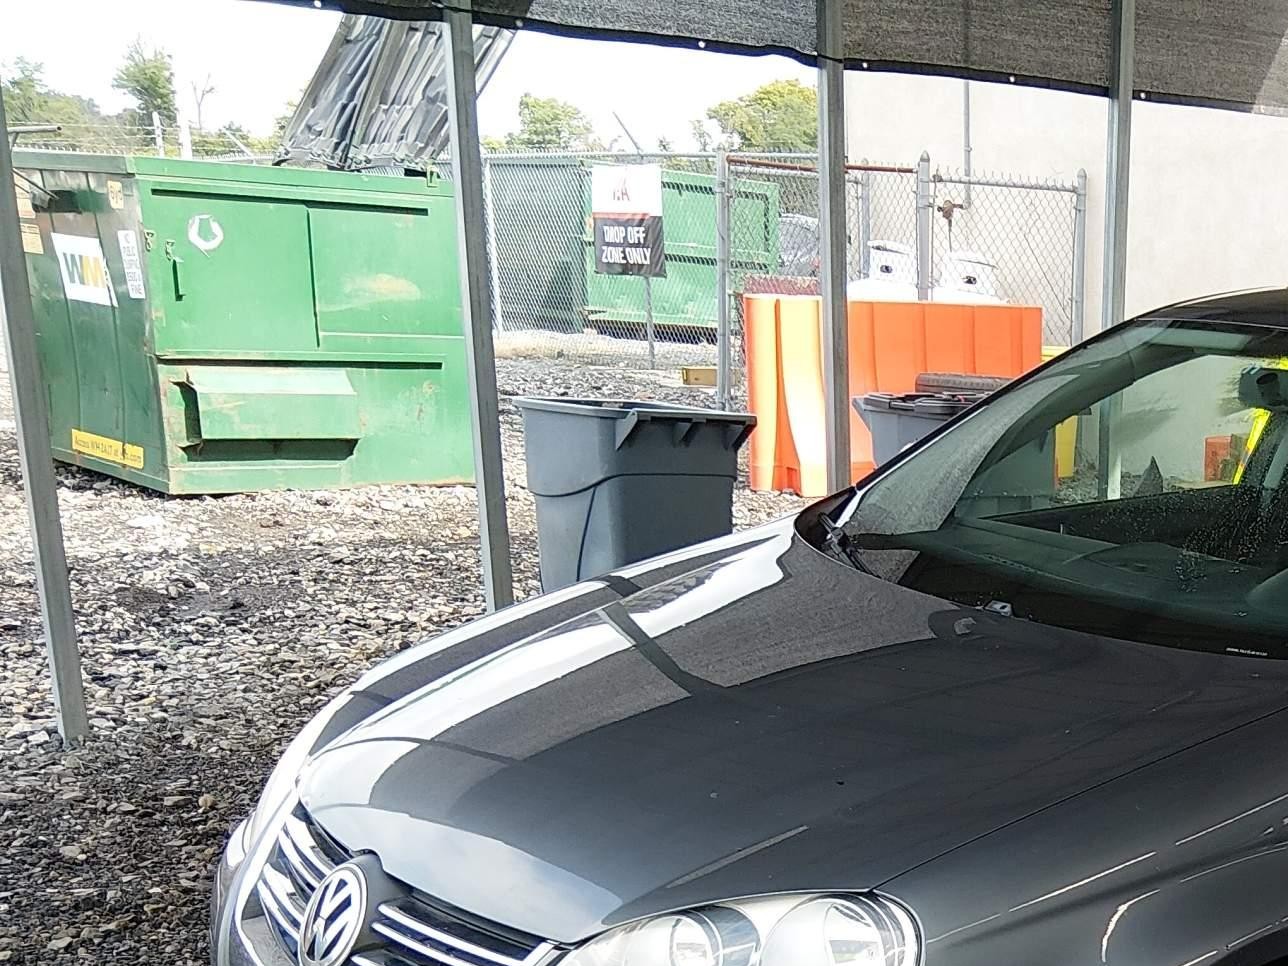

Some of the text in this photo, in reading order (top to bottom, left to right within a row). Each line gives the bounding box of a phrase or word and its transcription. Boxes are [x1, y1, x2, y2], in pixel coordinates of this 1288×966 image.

[603, 225, 647, 244] DROP OFF
[601, 246, 652, 265] ZONE ONLY
[62, 251, 107, 289] WM
